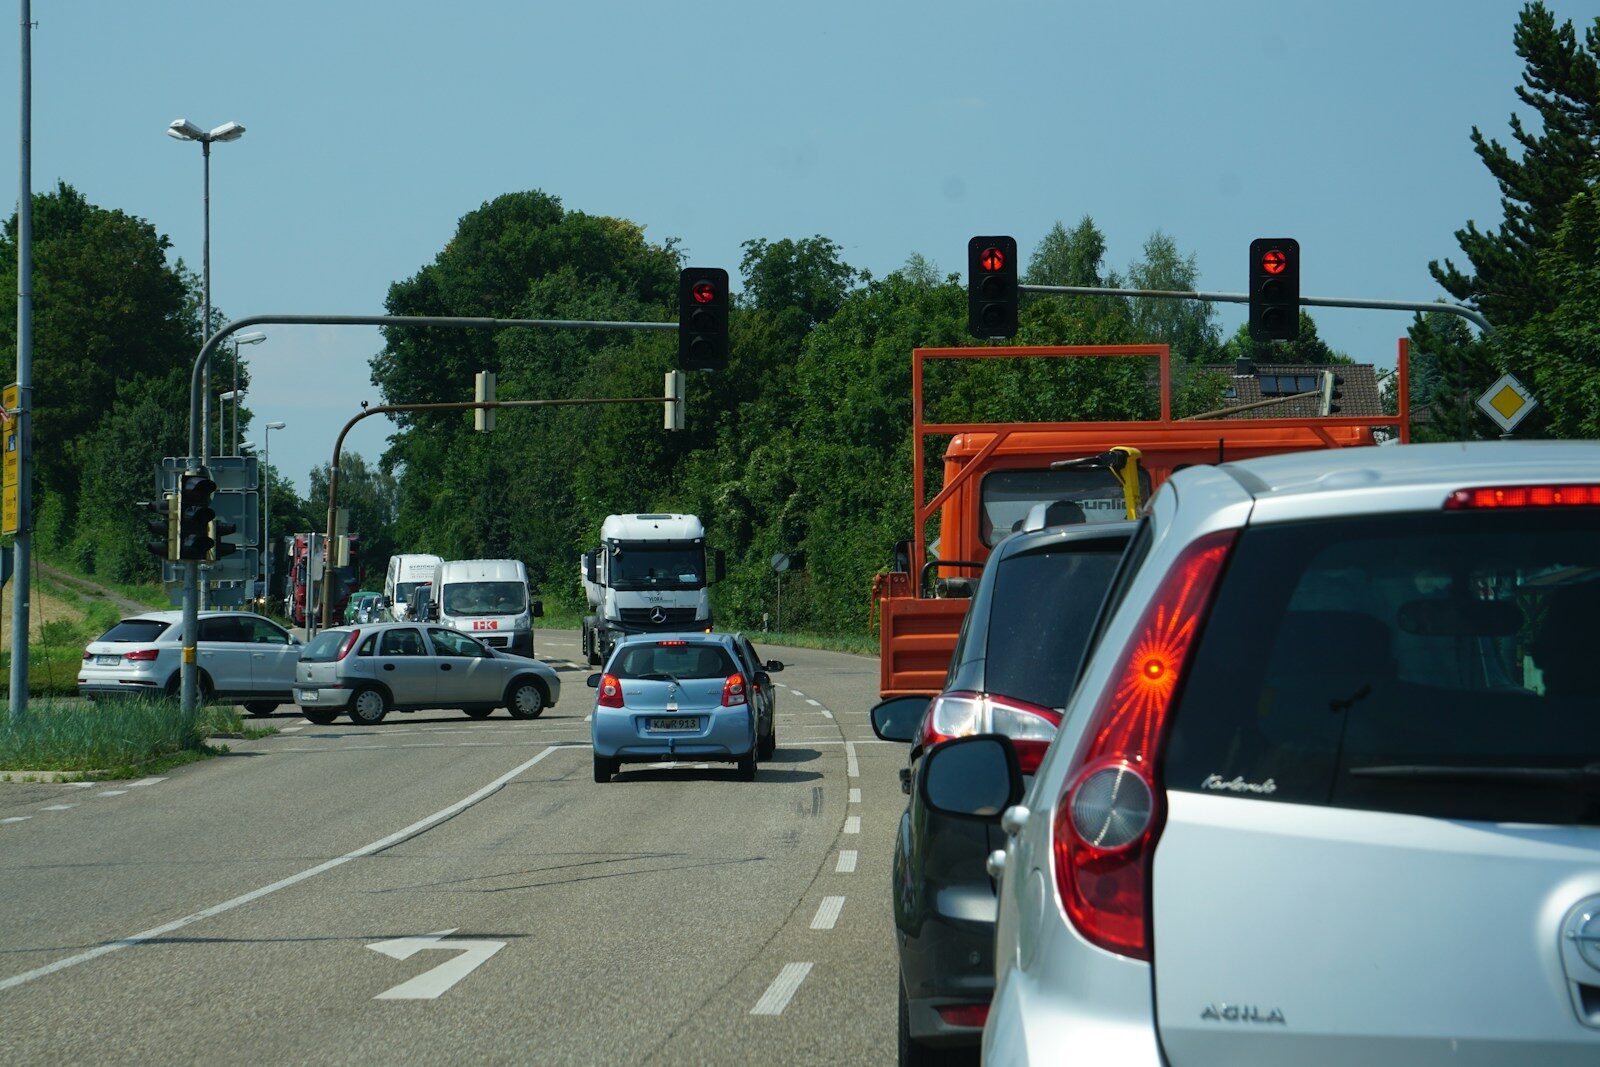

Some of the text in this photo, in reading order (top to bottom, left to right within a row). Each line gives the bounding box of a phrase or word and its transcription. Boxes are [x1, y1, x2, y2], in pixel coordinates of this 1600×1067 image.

[653, 719, 666, 729] KA
[679, 719, 697, 729] 913
[1201, 1004, 1285, 1023] AGILA
